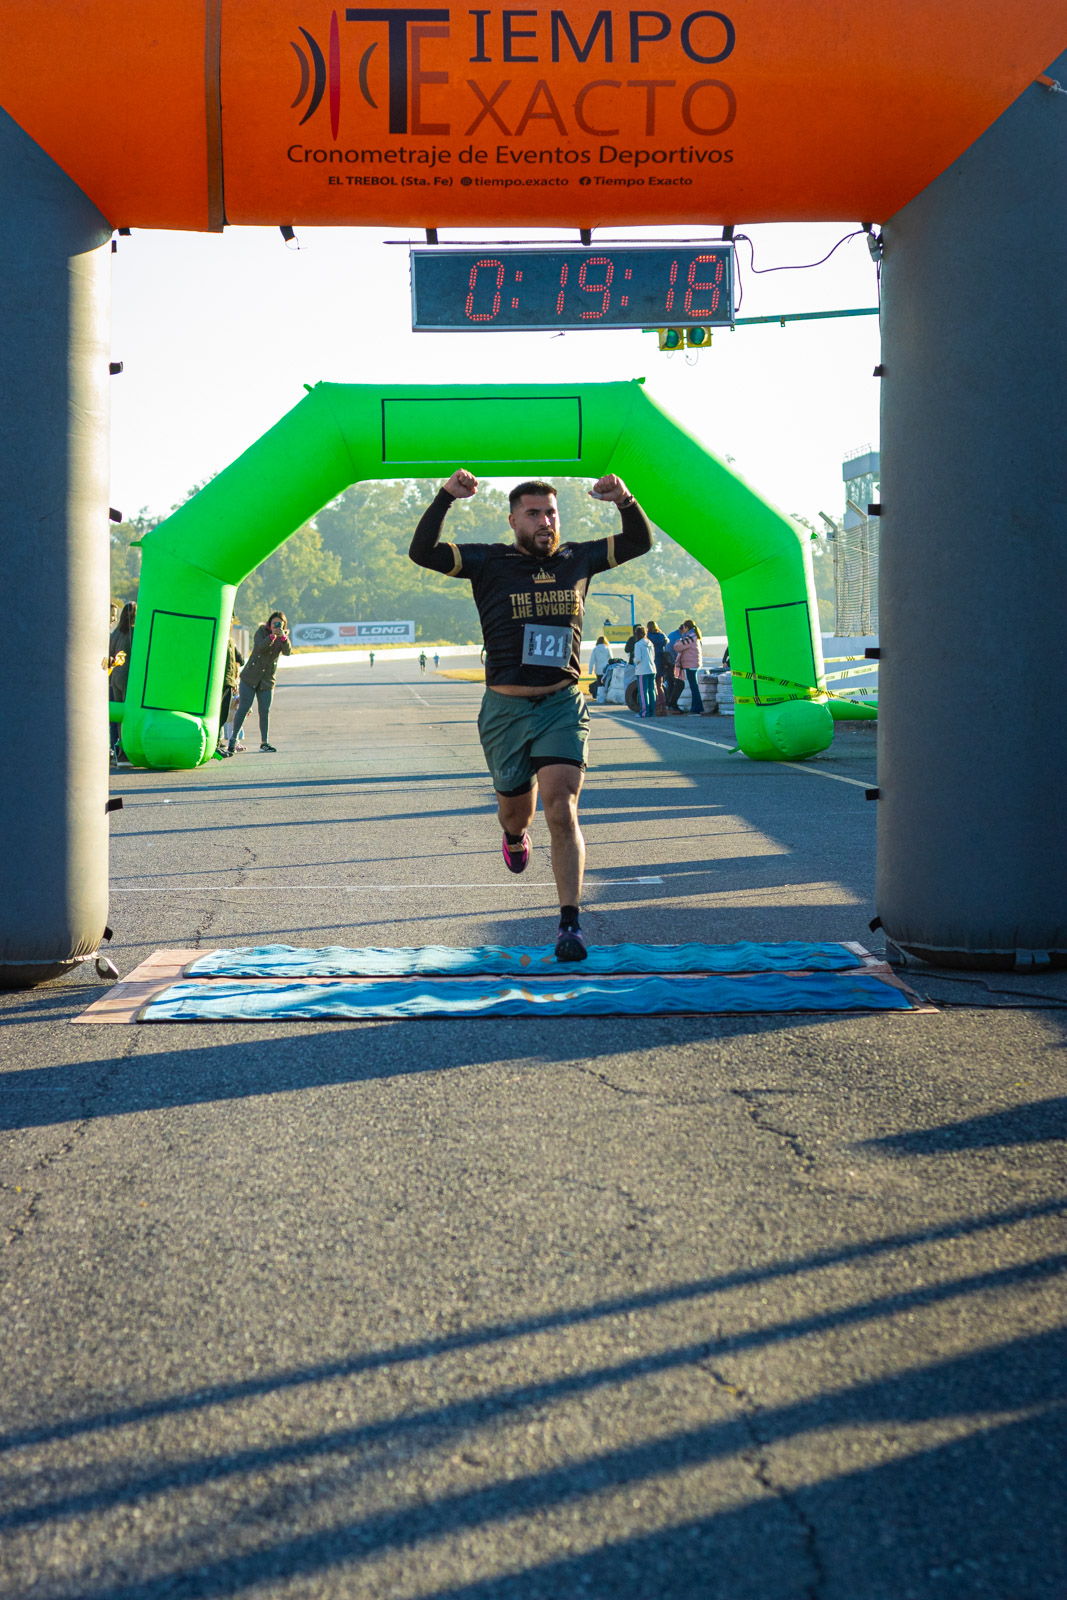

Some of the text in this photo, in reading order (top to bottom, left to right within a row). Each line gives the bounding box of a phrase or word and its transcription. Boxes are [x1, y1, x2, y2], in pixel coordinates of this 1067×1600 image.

[287, 144, 734, 168] Cronometraje de Eventos Deportivos
[328, 176, 693, 188] EL TREBOL (Sta. Fe) tiempo.exacto Tiempo Exacto
[509, 592, 531, 606] THE
[302, 626, 405, 639] Ford LONG
[534, 634, 564, 657] 121
